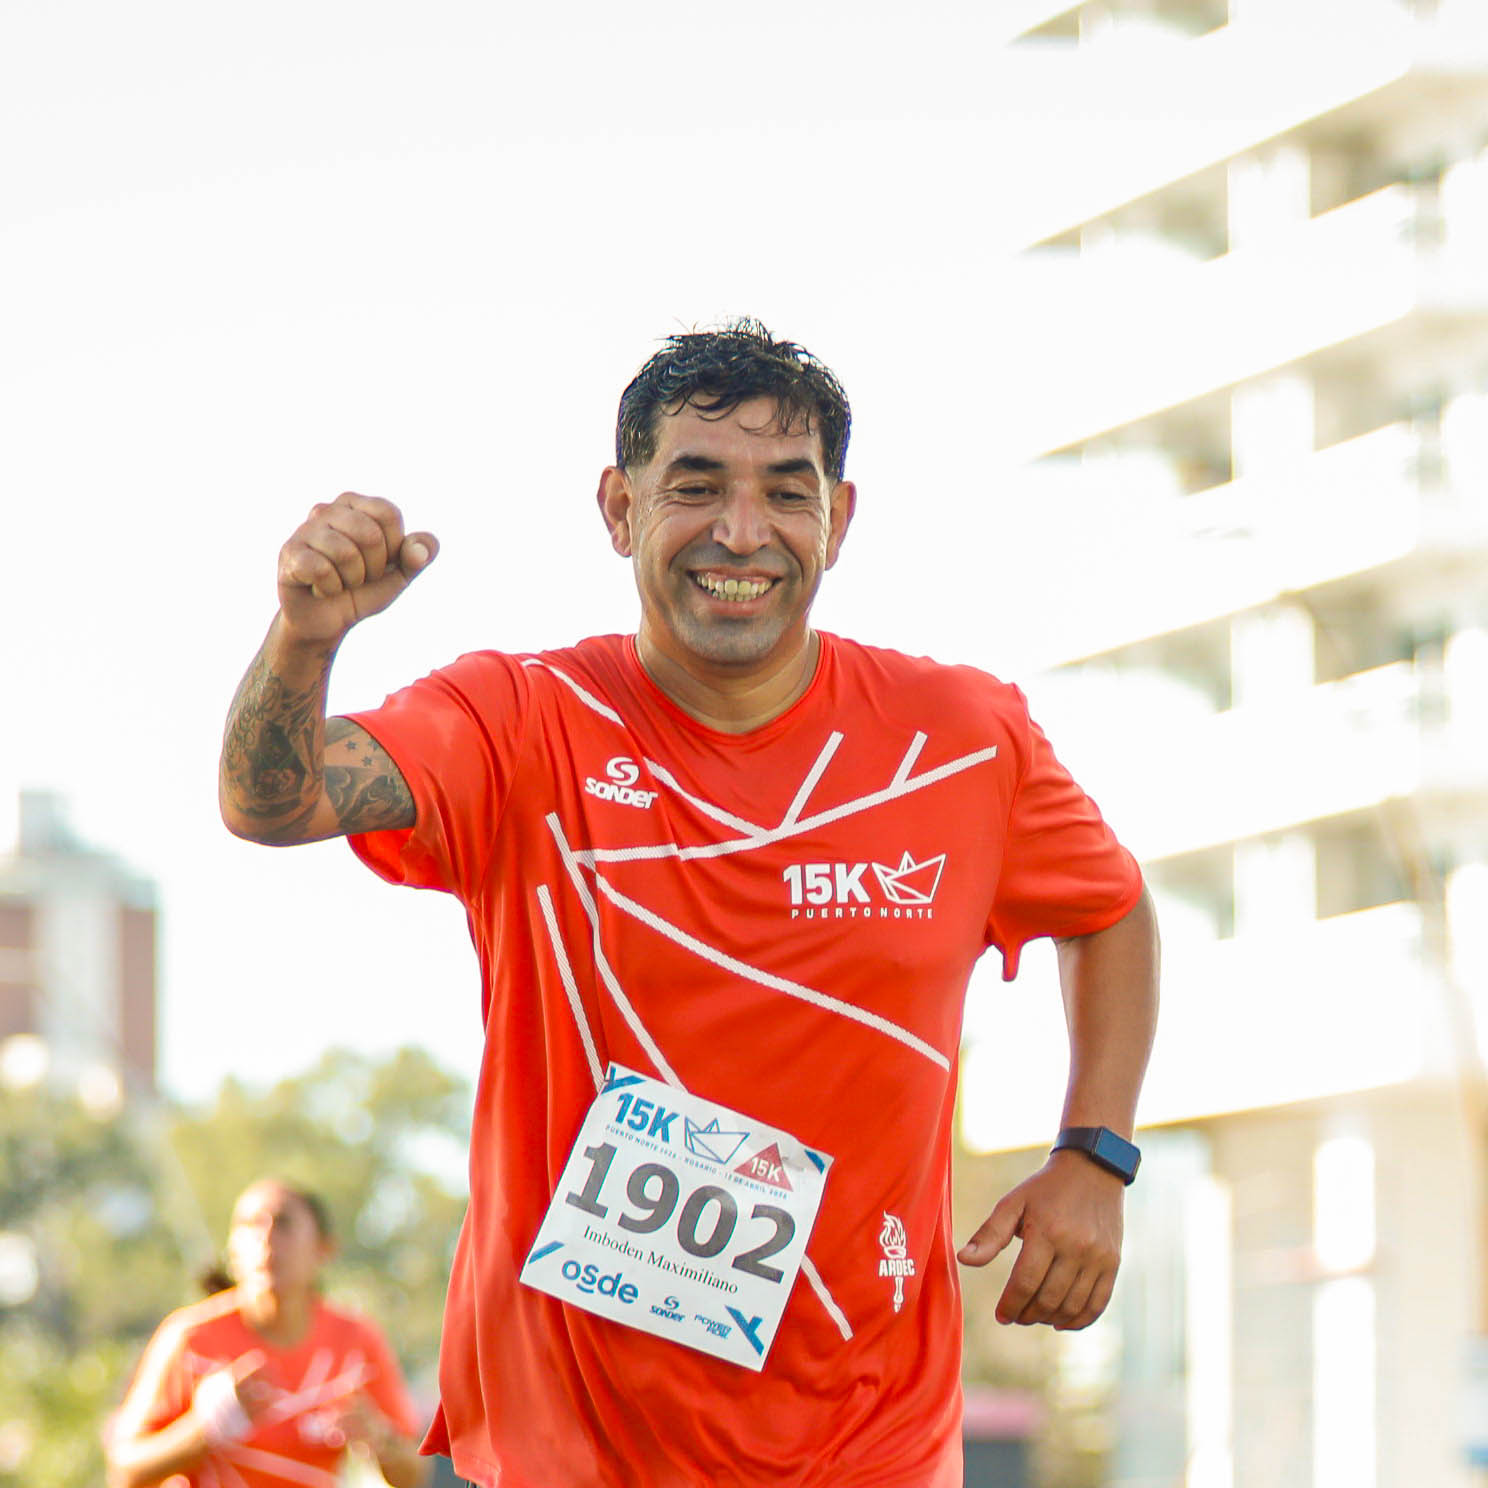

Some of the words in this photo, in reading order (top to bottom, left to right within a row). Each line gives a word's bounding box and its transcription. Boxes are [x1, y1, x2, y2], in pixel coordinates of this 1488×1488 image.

[783, 863, 871, 905] 15K
[791, 907, 871, 919] PUERTO
[880, 907, 933, 919] NORTE
[615, 1092, 680, 1144] 15K
[751, 1157, 782, 1182] 15K
[565, 1142, 796, 1284] 1902
[583, 1225, 643, 1261] Imboden
[647, 1251, 738, 1294] Maximiliano
[879, 1259, 915, 1276] ARDEC
[561, 1260, 639, 1304] osde
